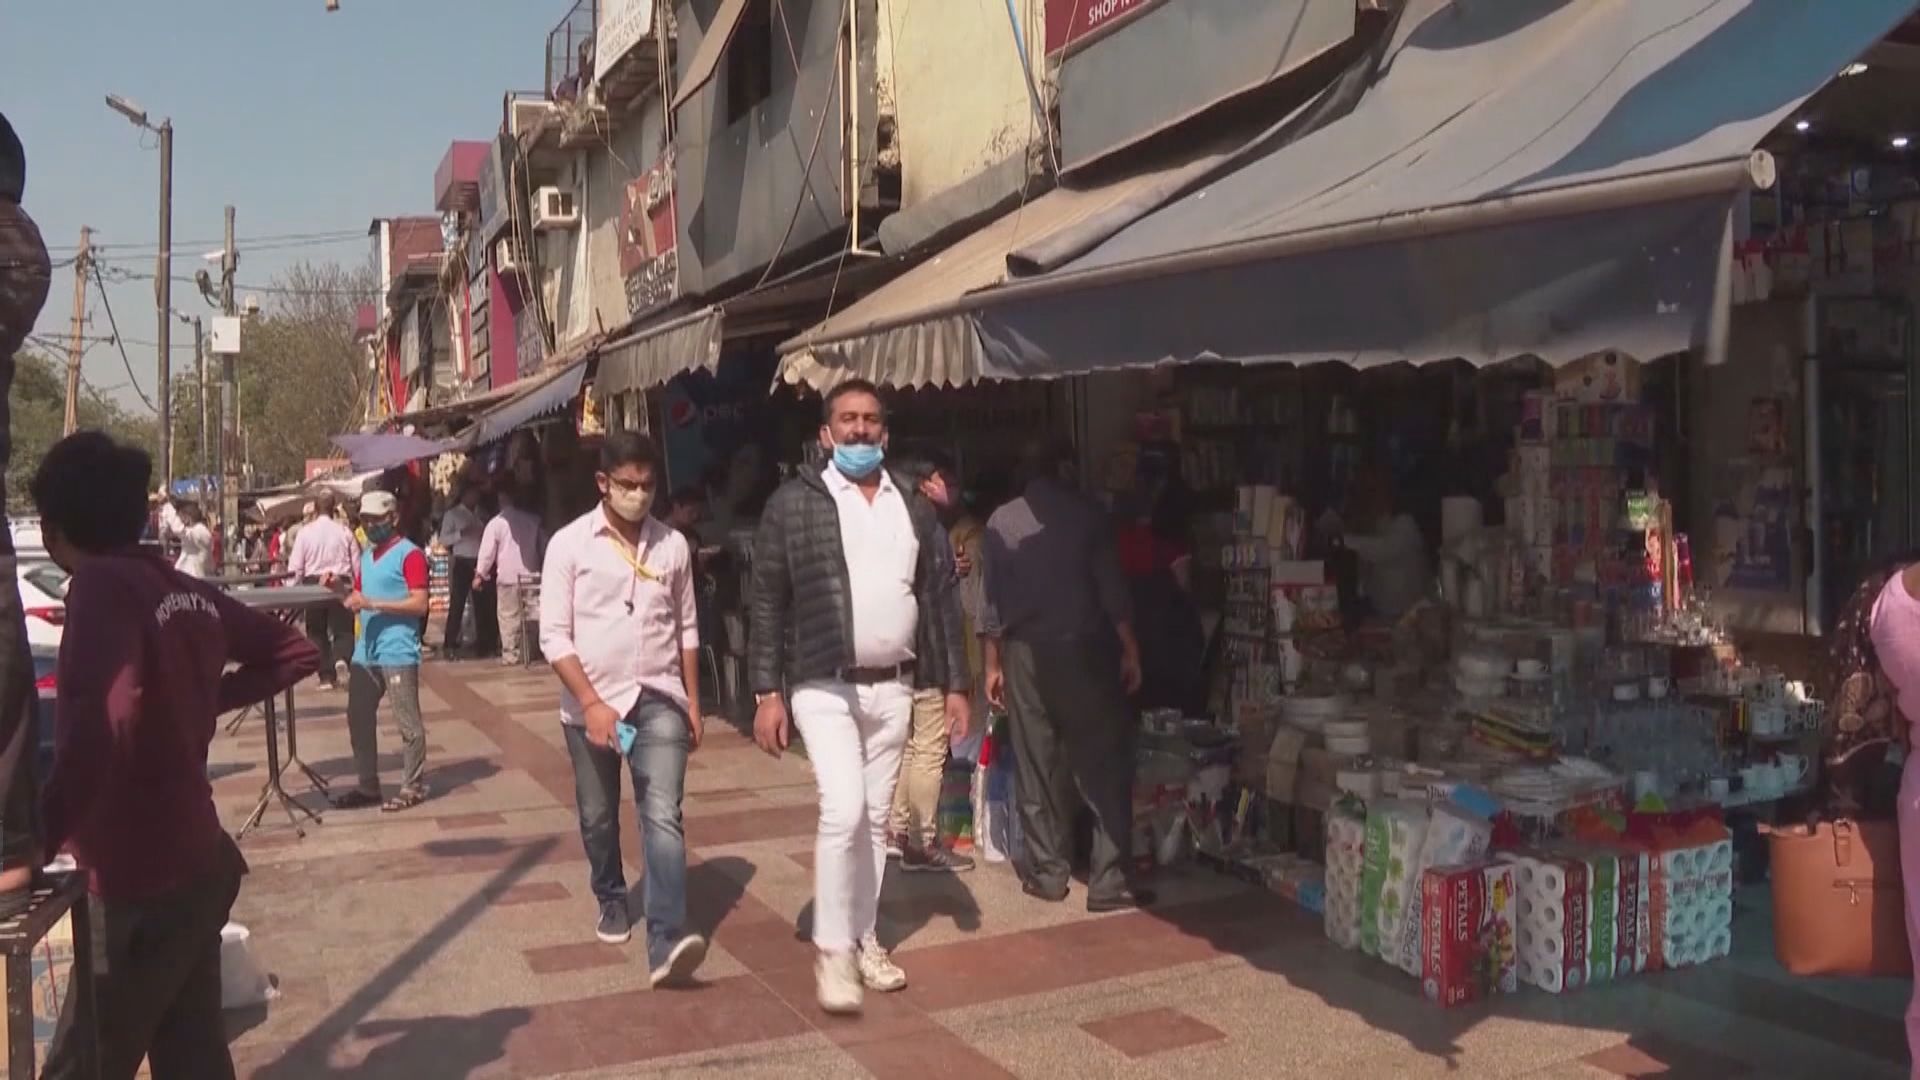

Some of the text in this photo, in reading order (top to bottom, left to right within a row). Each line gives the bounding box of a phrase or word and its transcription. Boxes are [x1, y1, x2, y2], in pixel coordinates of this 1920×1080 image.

[1088, 0, 1117, 25] SHOP
[1431, 905, 1441, 976] PETALS
[1457, 879, 1468, 941] PETALS
[1573, 895, 1583, 960] PETALS
[1601, 888, 1610, 953] PETALS
[1625, 883, 1635, 947] PETALS
